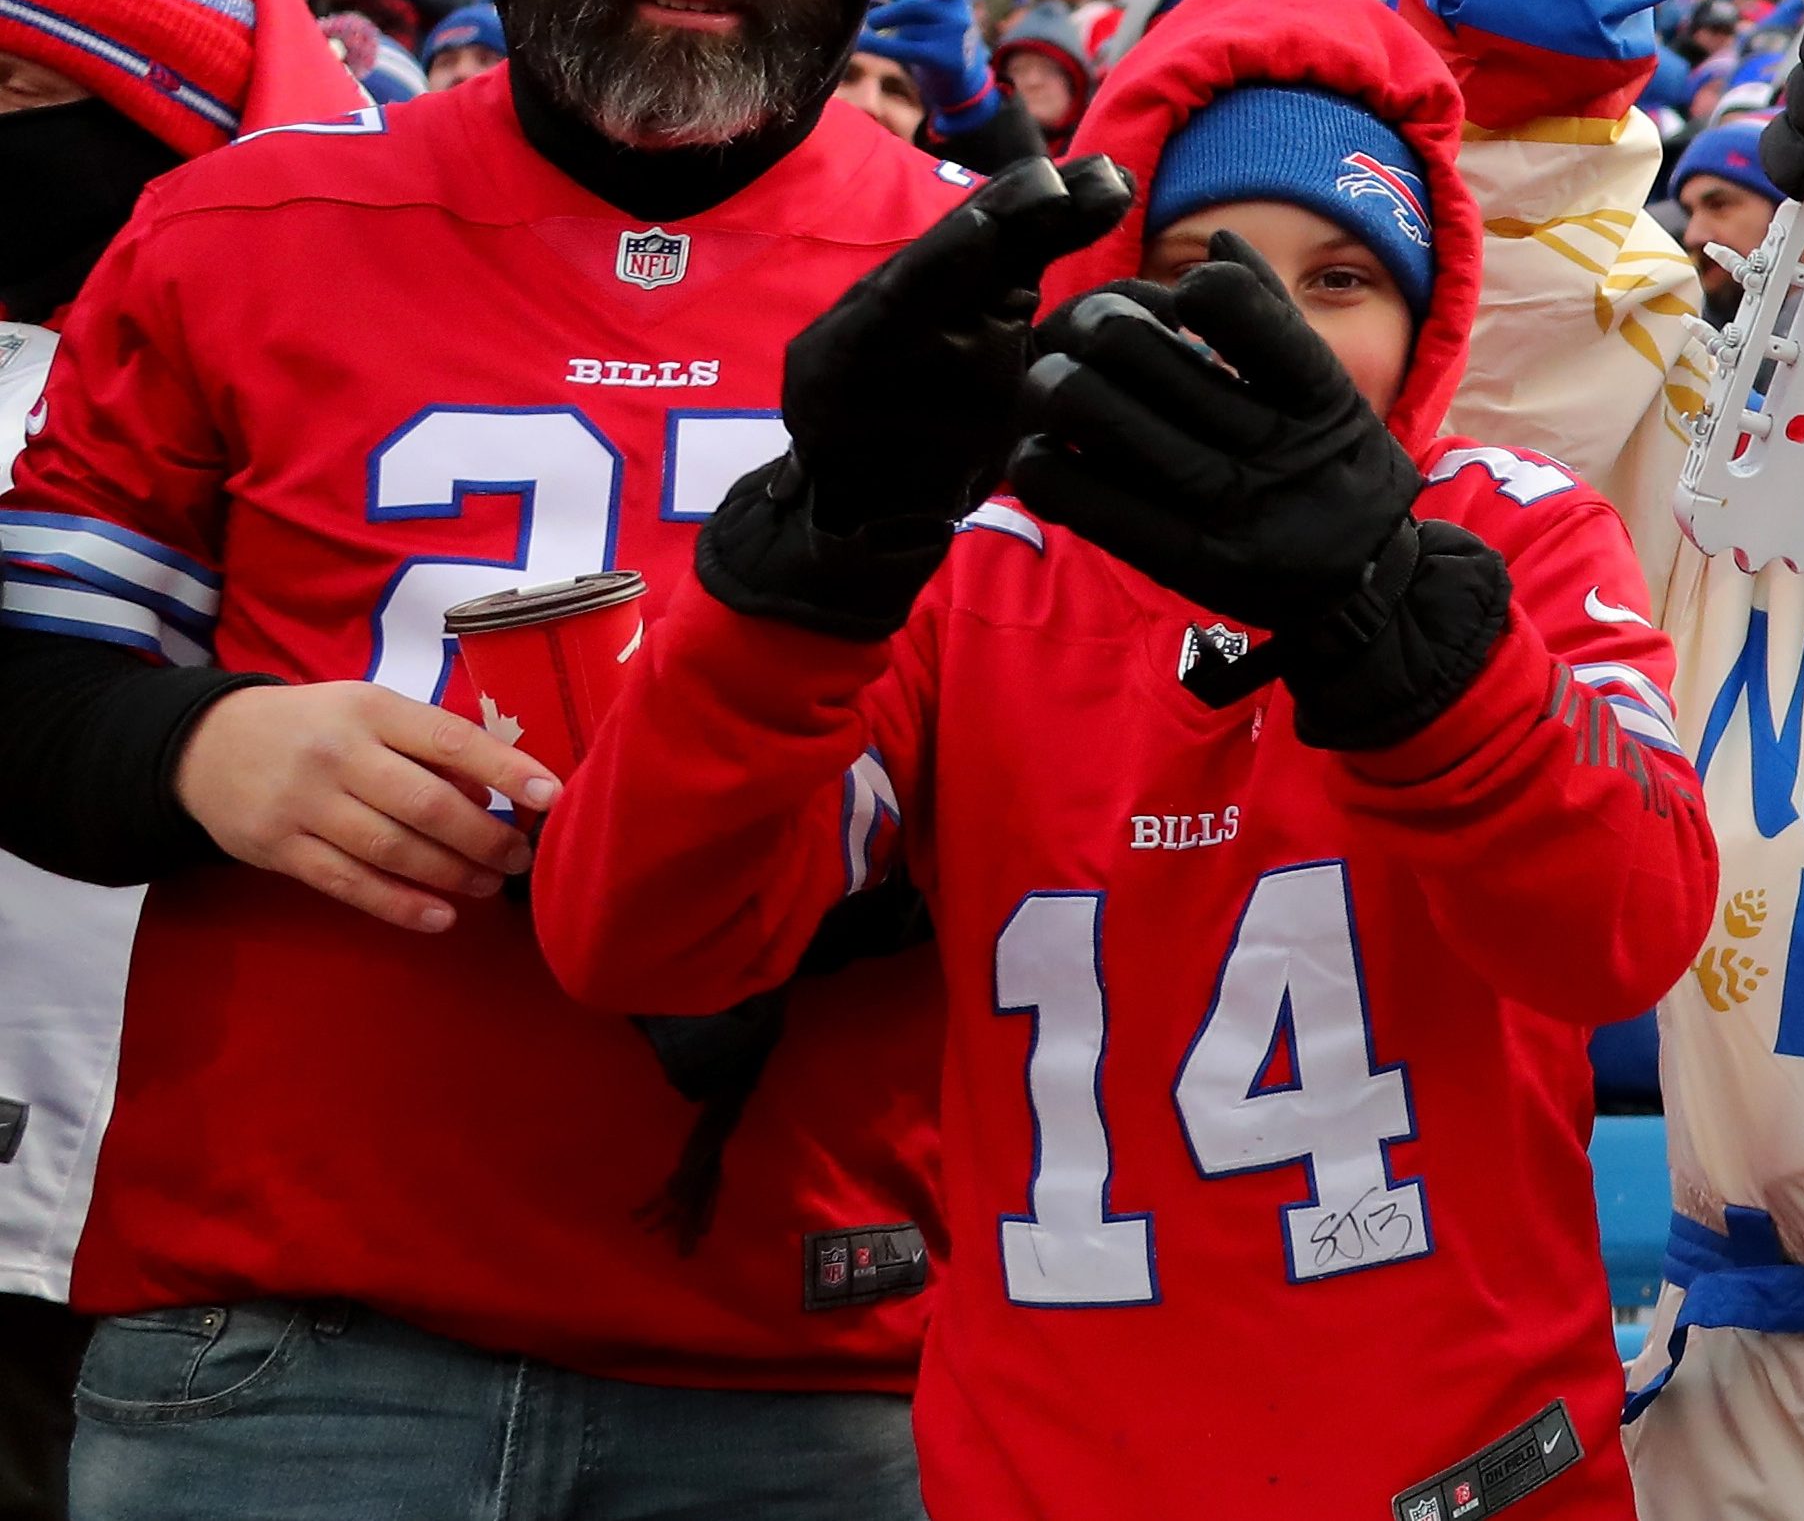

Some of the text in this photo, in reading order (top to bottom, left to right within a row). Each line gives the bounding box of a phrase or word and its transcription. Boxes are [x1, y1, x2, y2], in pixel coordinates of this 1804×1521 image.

[629, 253, 675, 279] NFL
[565, 357, 720, 388] BILLS
[1130, 805, 1241, 851] BILLS
[992, 857, 1436, 1311] 14
